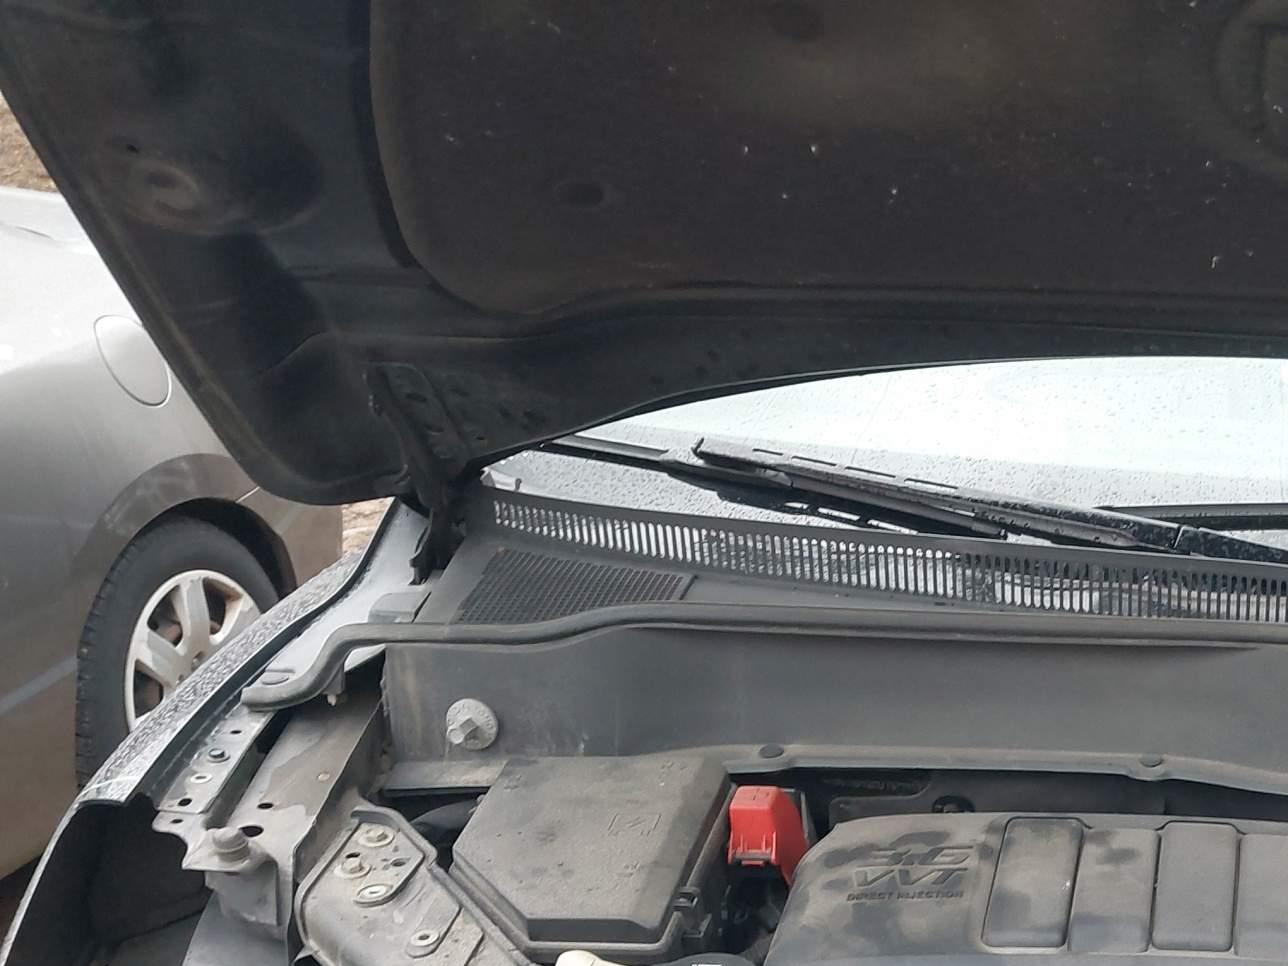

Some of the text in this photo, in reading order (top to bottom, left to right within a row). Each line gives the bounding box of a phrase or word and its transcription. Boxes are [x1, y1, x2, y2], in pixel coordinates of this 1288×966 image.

[855, 867, 969, 887] VVT
[846, 889, 965, 902] DIRECT INJECTION
